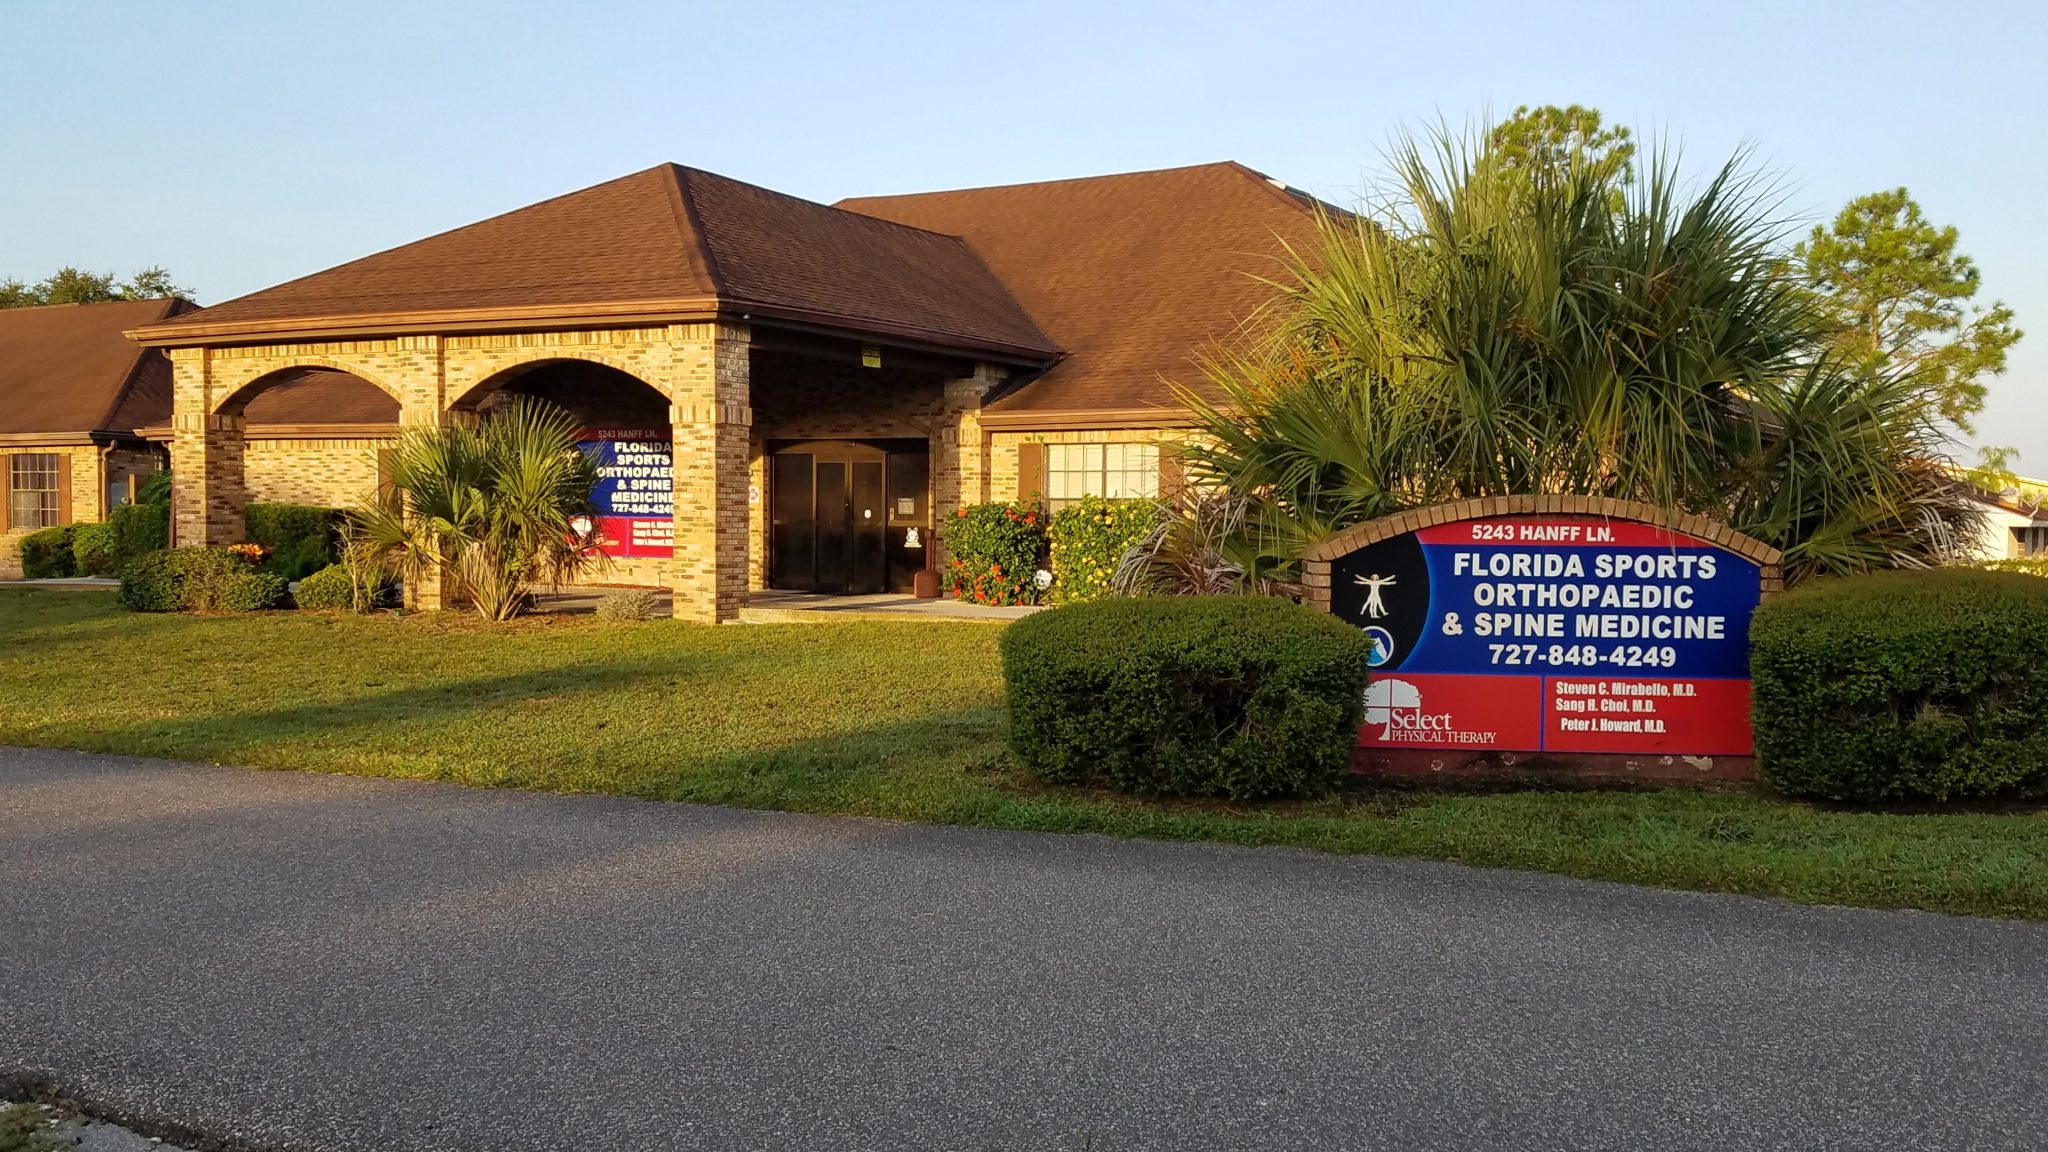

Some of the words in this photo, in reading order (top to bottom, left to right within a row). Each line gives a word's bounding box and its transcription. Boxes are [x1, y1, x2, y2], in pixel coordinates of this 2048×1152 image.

[614, 442, 672, 453] FLORIDA
[617, 454, 670, 465] SPORTS
[596, 467, 673, 478] ORTHOPAE
[617, 480, 627, 490] &
[630, 480, 671, 490] SPINE
[1472, 525, 1514, 540] 5243
[1520, 526, 1580, 541] HANFF
[1586, 527, 1615, 542] LN.
[1454, 552, 1585, 578] FLORIDA
[1594, 554, 1717, 579] SPORTS
[1474, 583, 1694, 608] ORTHOPAEDIC
[1442, 612, 1463, 636] &
[1474, 613, 1565, 637] SPINE
[1576, 614, 1725, 639] MEDICINE
[1488, 644, 1676, 667] 727-848-4249
[1556, 682, 1596, 695] Steven
[1598, 682, 1610, 695] C.
[1612, 682, 1670, 697] Mirabello,
[1673, 684, 1697, 696] M.D.
[1556, 698, 1585, 712] Sang
[1588, 699, 1598, 711] H.
[1600, 699, 1630, 713] Choi,
[1632, 700, 1656, 712] M.D.
[1392, 708, 1452, 730] Select
[1561, 718, 1590, 731] Peter
[1591, 718, 1598, 732] J.
[1600, 719, 1642, 733] Howard,
[1644, 720, 1666, 732] M.D.
[1392, 730, 1444, 742] PHYSICAL
[1446, 732, 1497, 744] THERAPY
